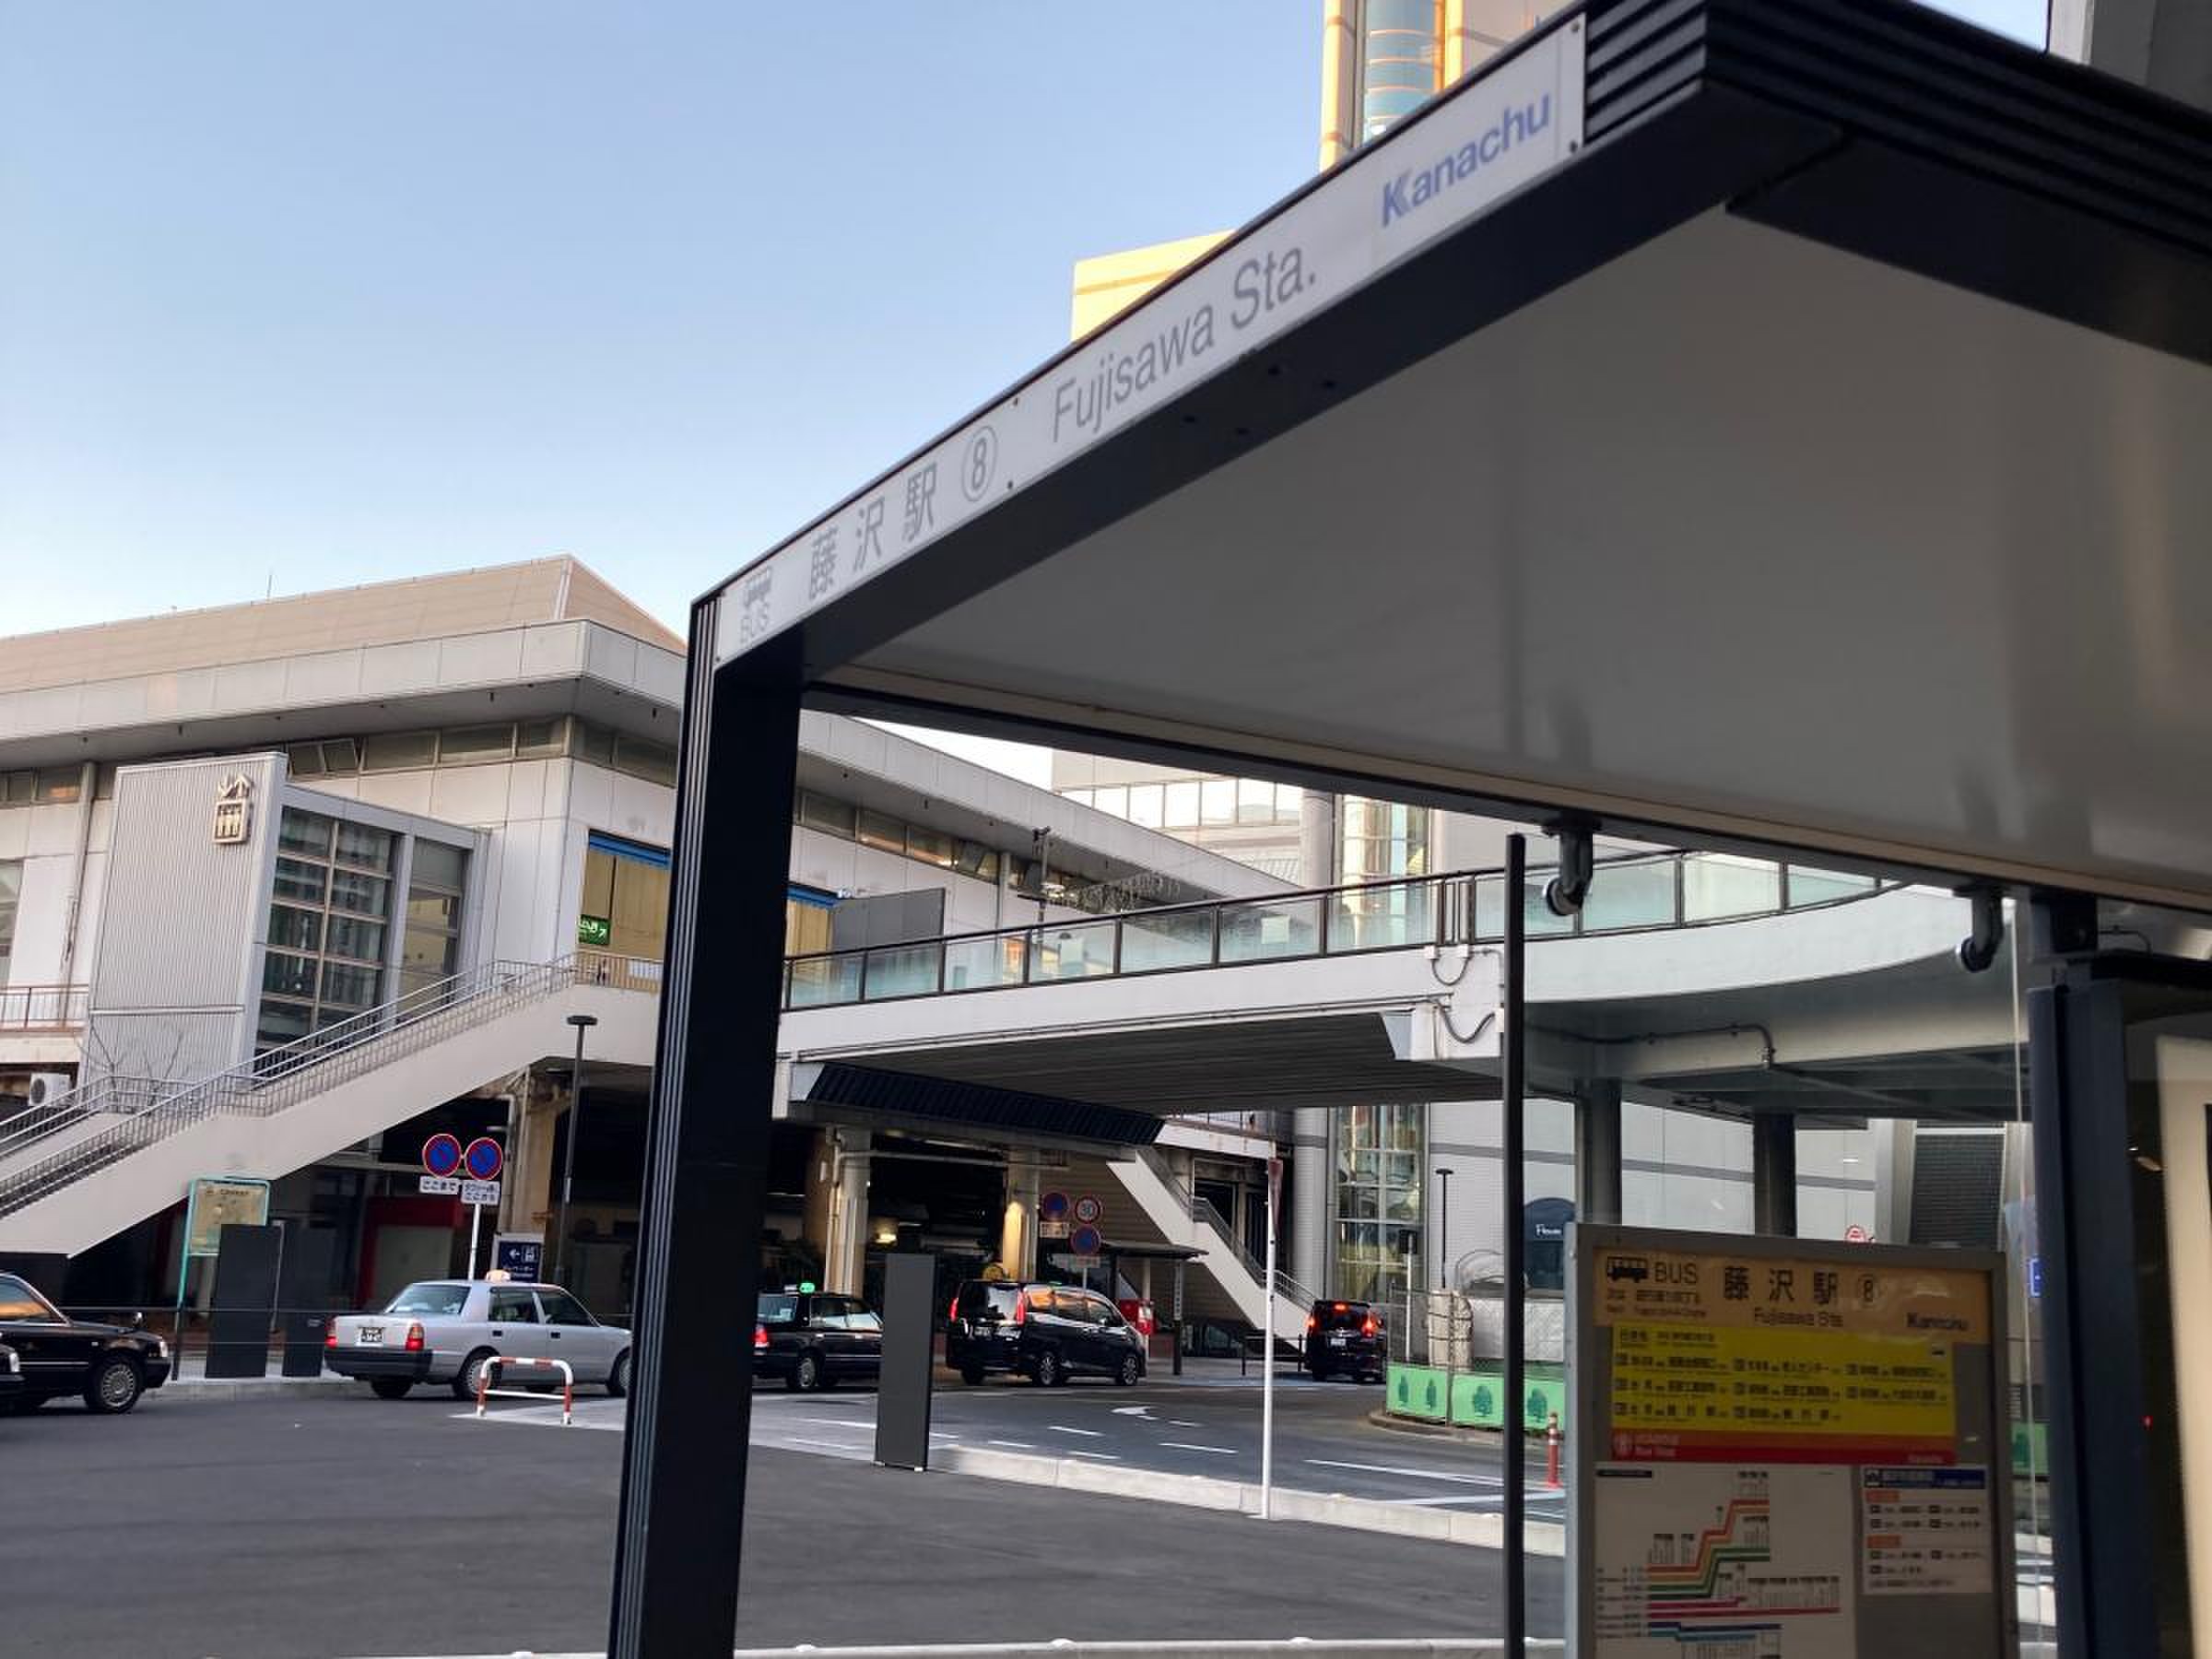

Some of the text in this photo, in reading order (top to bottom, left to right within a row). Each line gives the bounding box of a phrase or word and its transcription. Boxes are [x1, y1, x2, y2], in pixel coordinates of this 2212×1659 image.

[1382, 93, 1552, 228] Kanachu
[1052, 245, 1316, 442] Fujisawa Sta.
[809, 465, 937, 600] 藤沢駅
[739, 603, 771, 645] BUS
[1654, 1261, 1699, 1284] BUS
[1724, 1265, 1839, 1305] 藤沢駅
